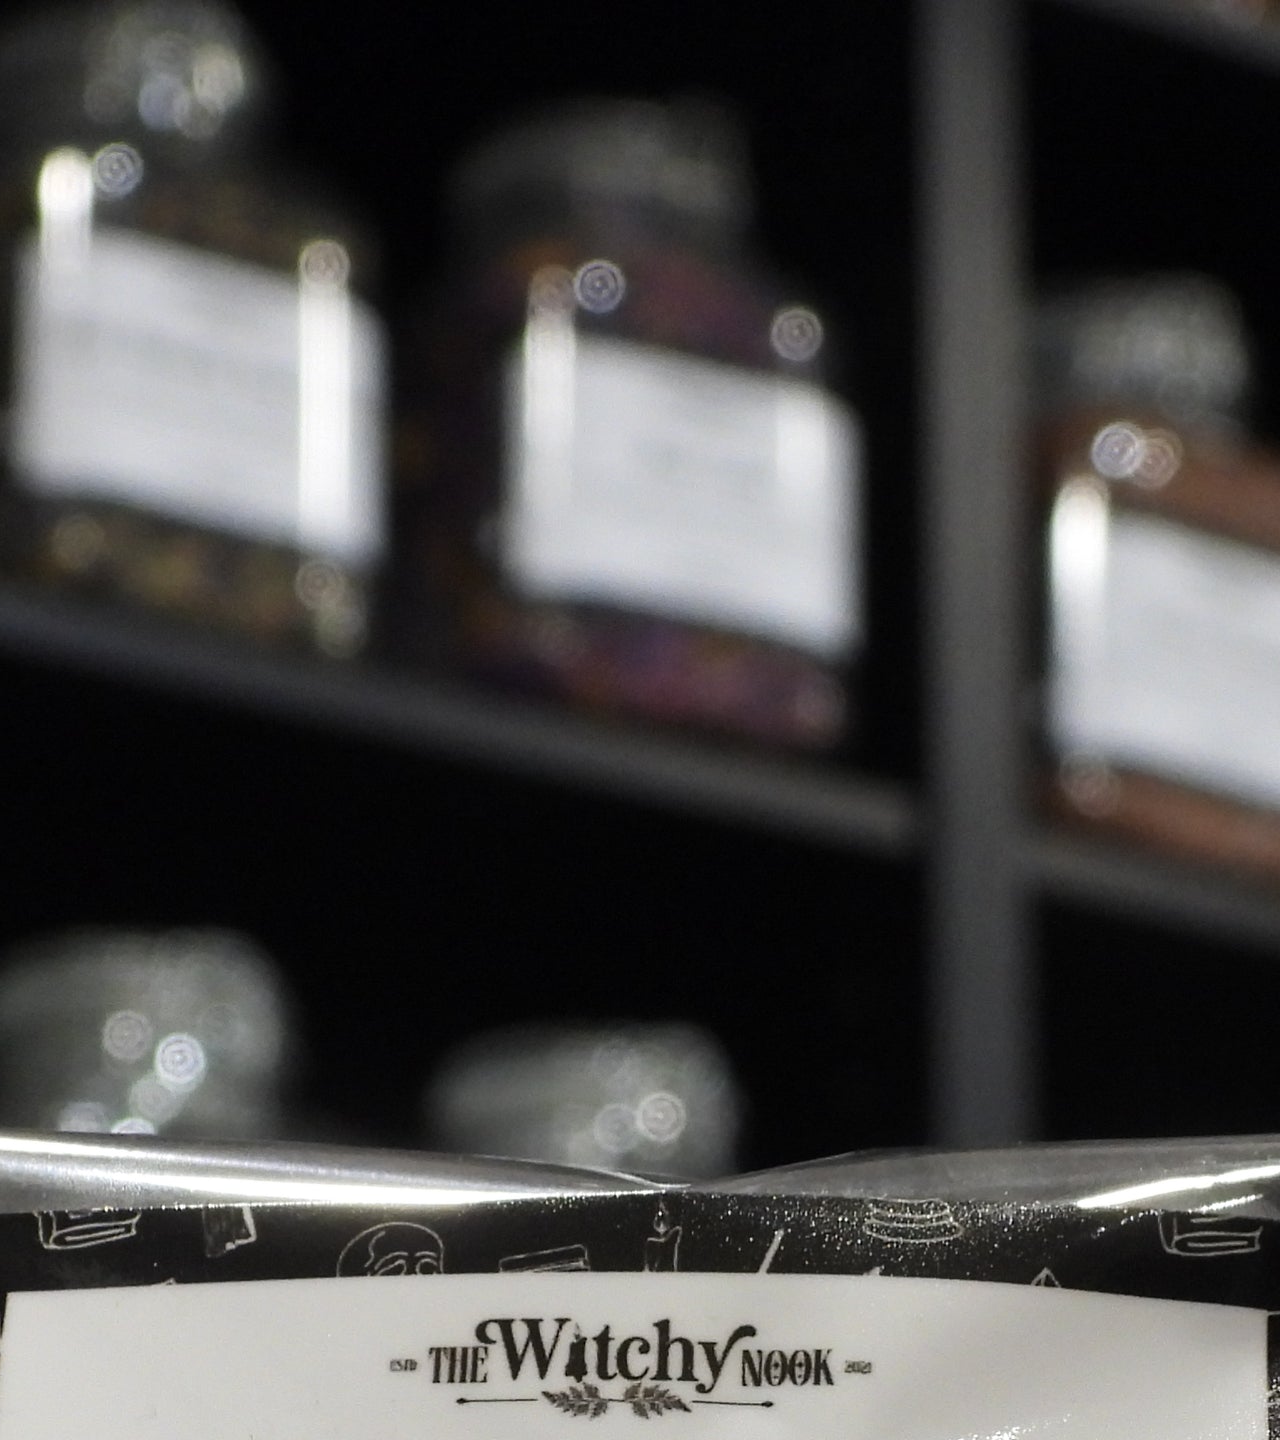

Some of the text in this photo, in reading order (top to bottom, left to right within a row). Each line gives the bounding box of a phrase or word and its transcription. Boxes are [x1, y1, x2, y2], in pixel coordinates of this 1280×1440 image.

[429, 1346, 489, 1383] THE
[475, 1317, 757, 1394] Witchy
[741, 1348, 835, 1387] NOOK
